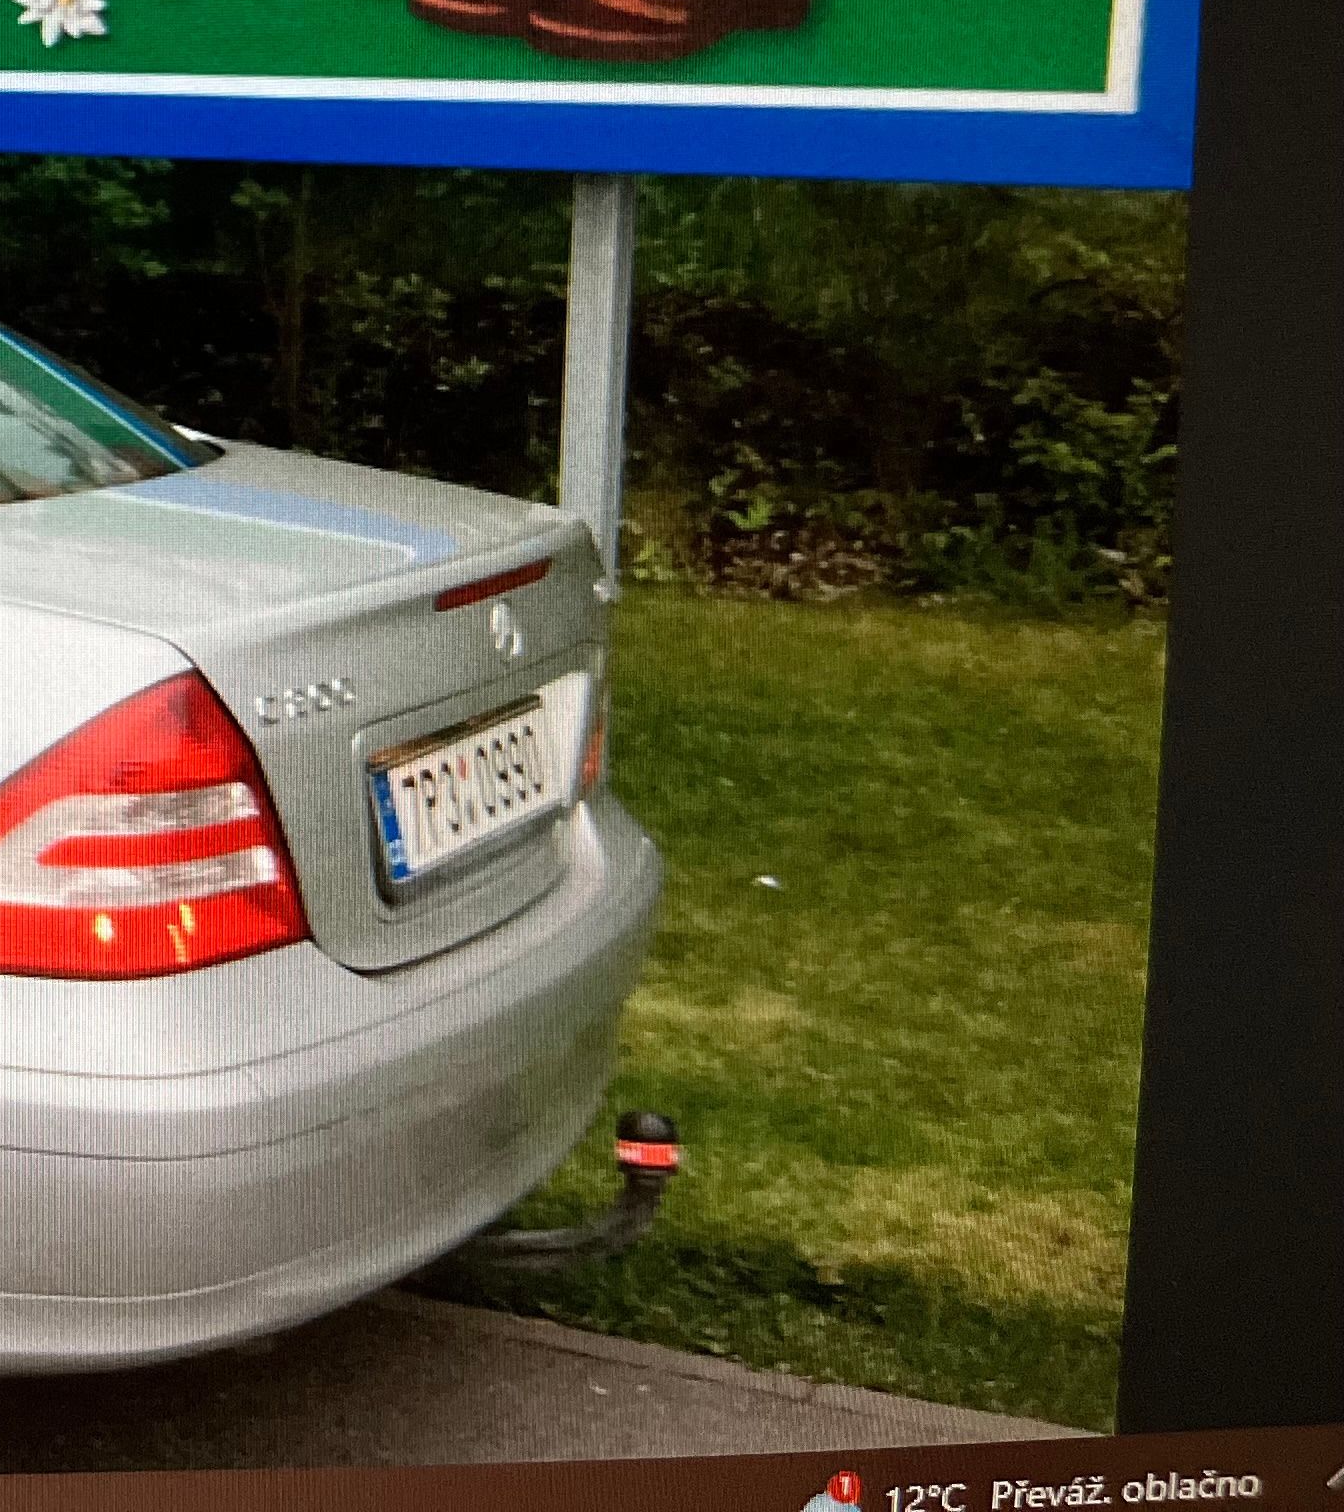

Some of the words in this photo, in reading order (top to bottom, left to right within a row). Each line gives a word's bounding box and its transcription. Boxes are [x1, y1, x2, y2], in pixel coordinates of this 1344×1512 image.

[885, 1483, 968, 1512] 12°C
[991, 1475, 1112, 1512] Převáž.
[1121, 1467, 1260, 1505] oblačno
